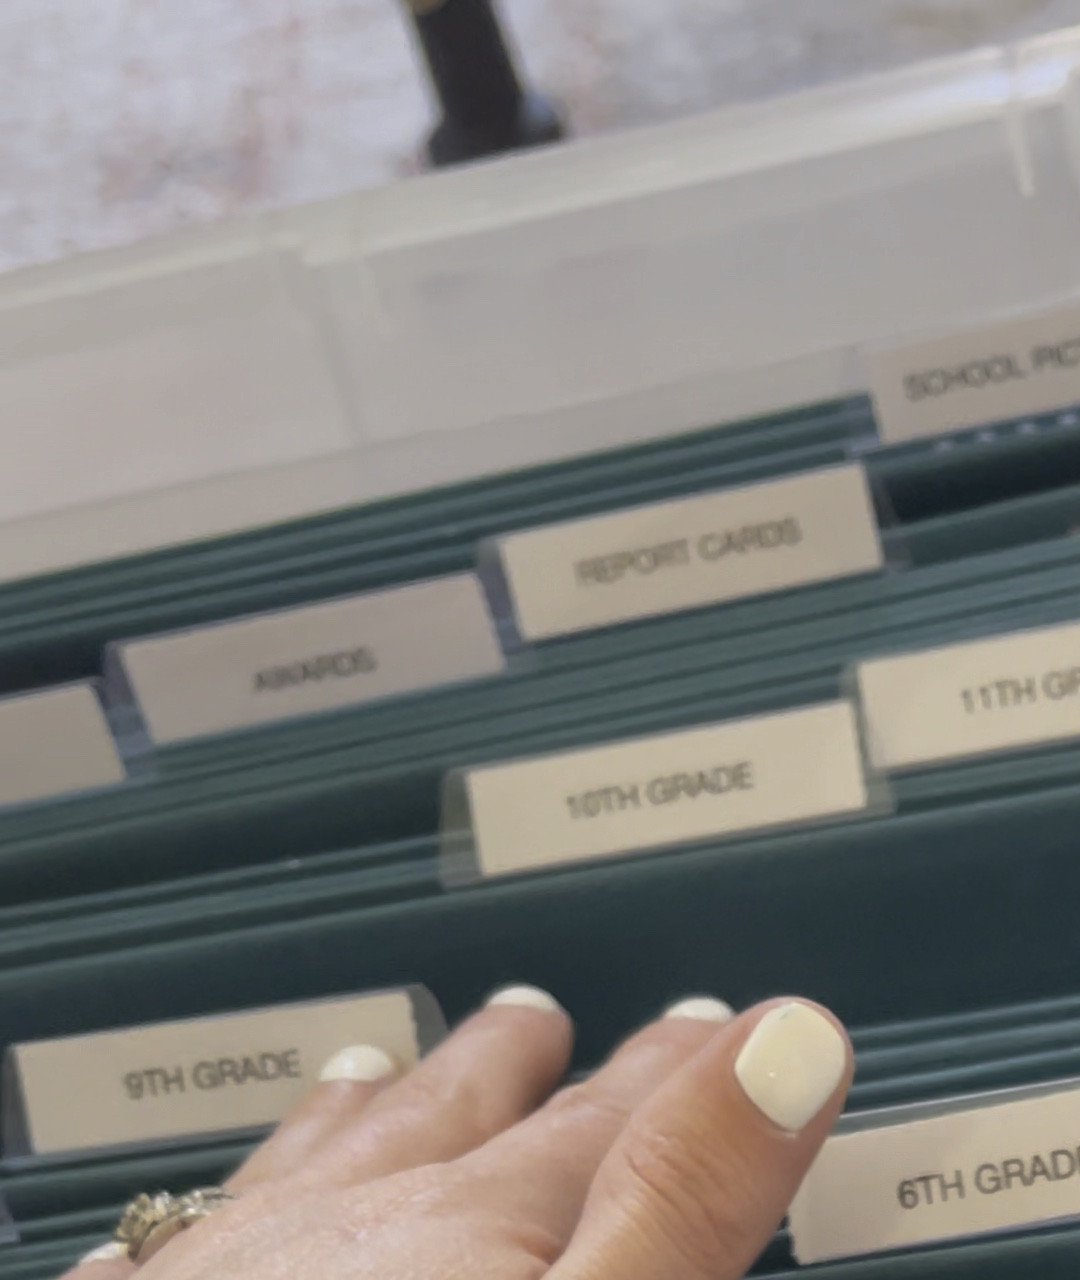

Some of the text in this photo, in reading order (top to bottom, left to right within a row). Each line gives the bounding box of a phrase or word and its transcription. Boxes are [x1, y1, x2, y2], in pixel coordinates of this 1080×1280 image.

[903, 354, 1026, 402] SCHOOL
[575, 517, 803, 585] REPORT CARDS
[254, 647, 378, 691] AWARDS
[960, 677, 1038, 714] 11TH
[565, 761, 754, 819] 10TH GRADE
[122, 1048, 302, 1101] 9TH GRADE
[896, 1169, 966, 1210] 6TH
